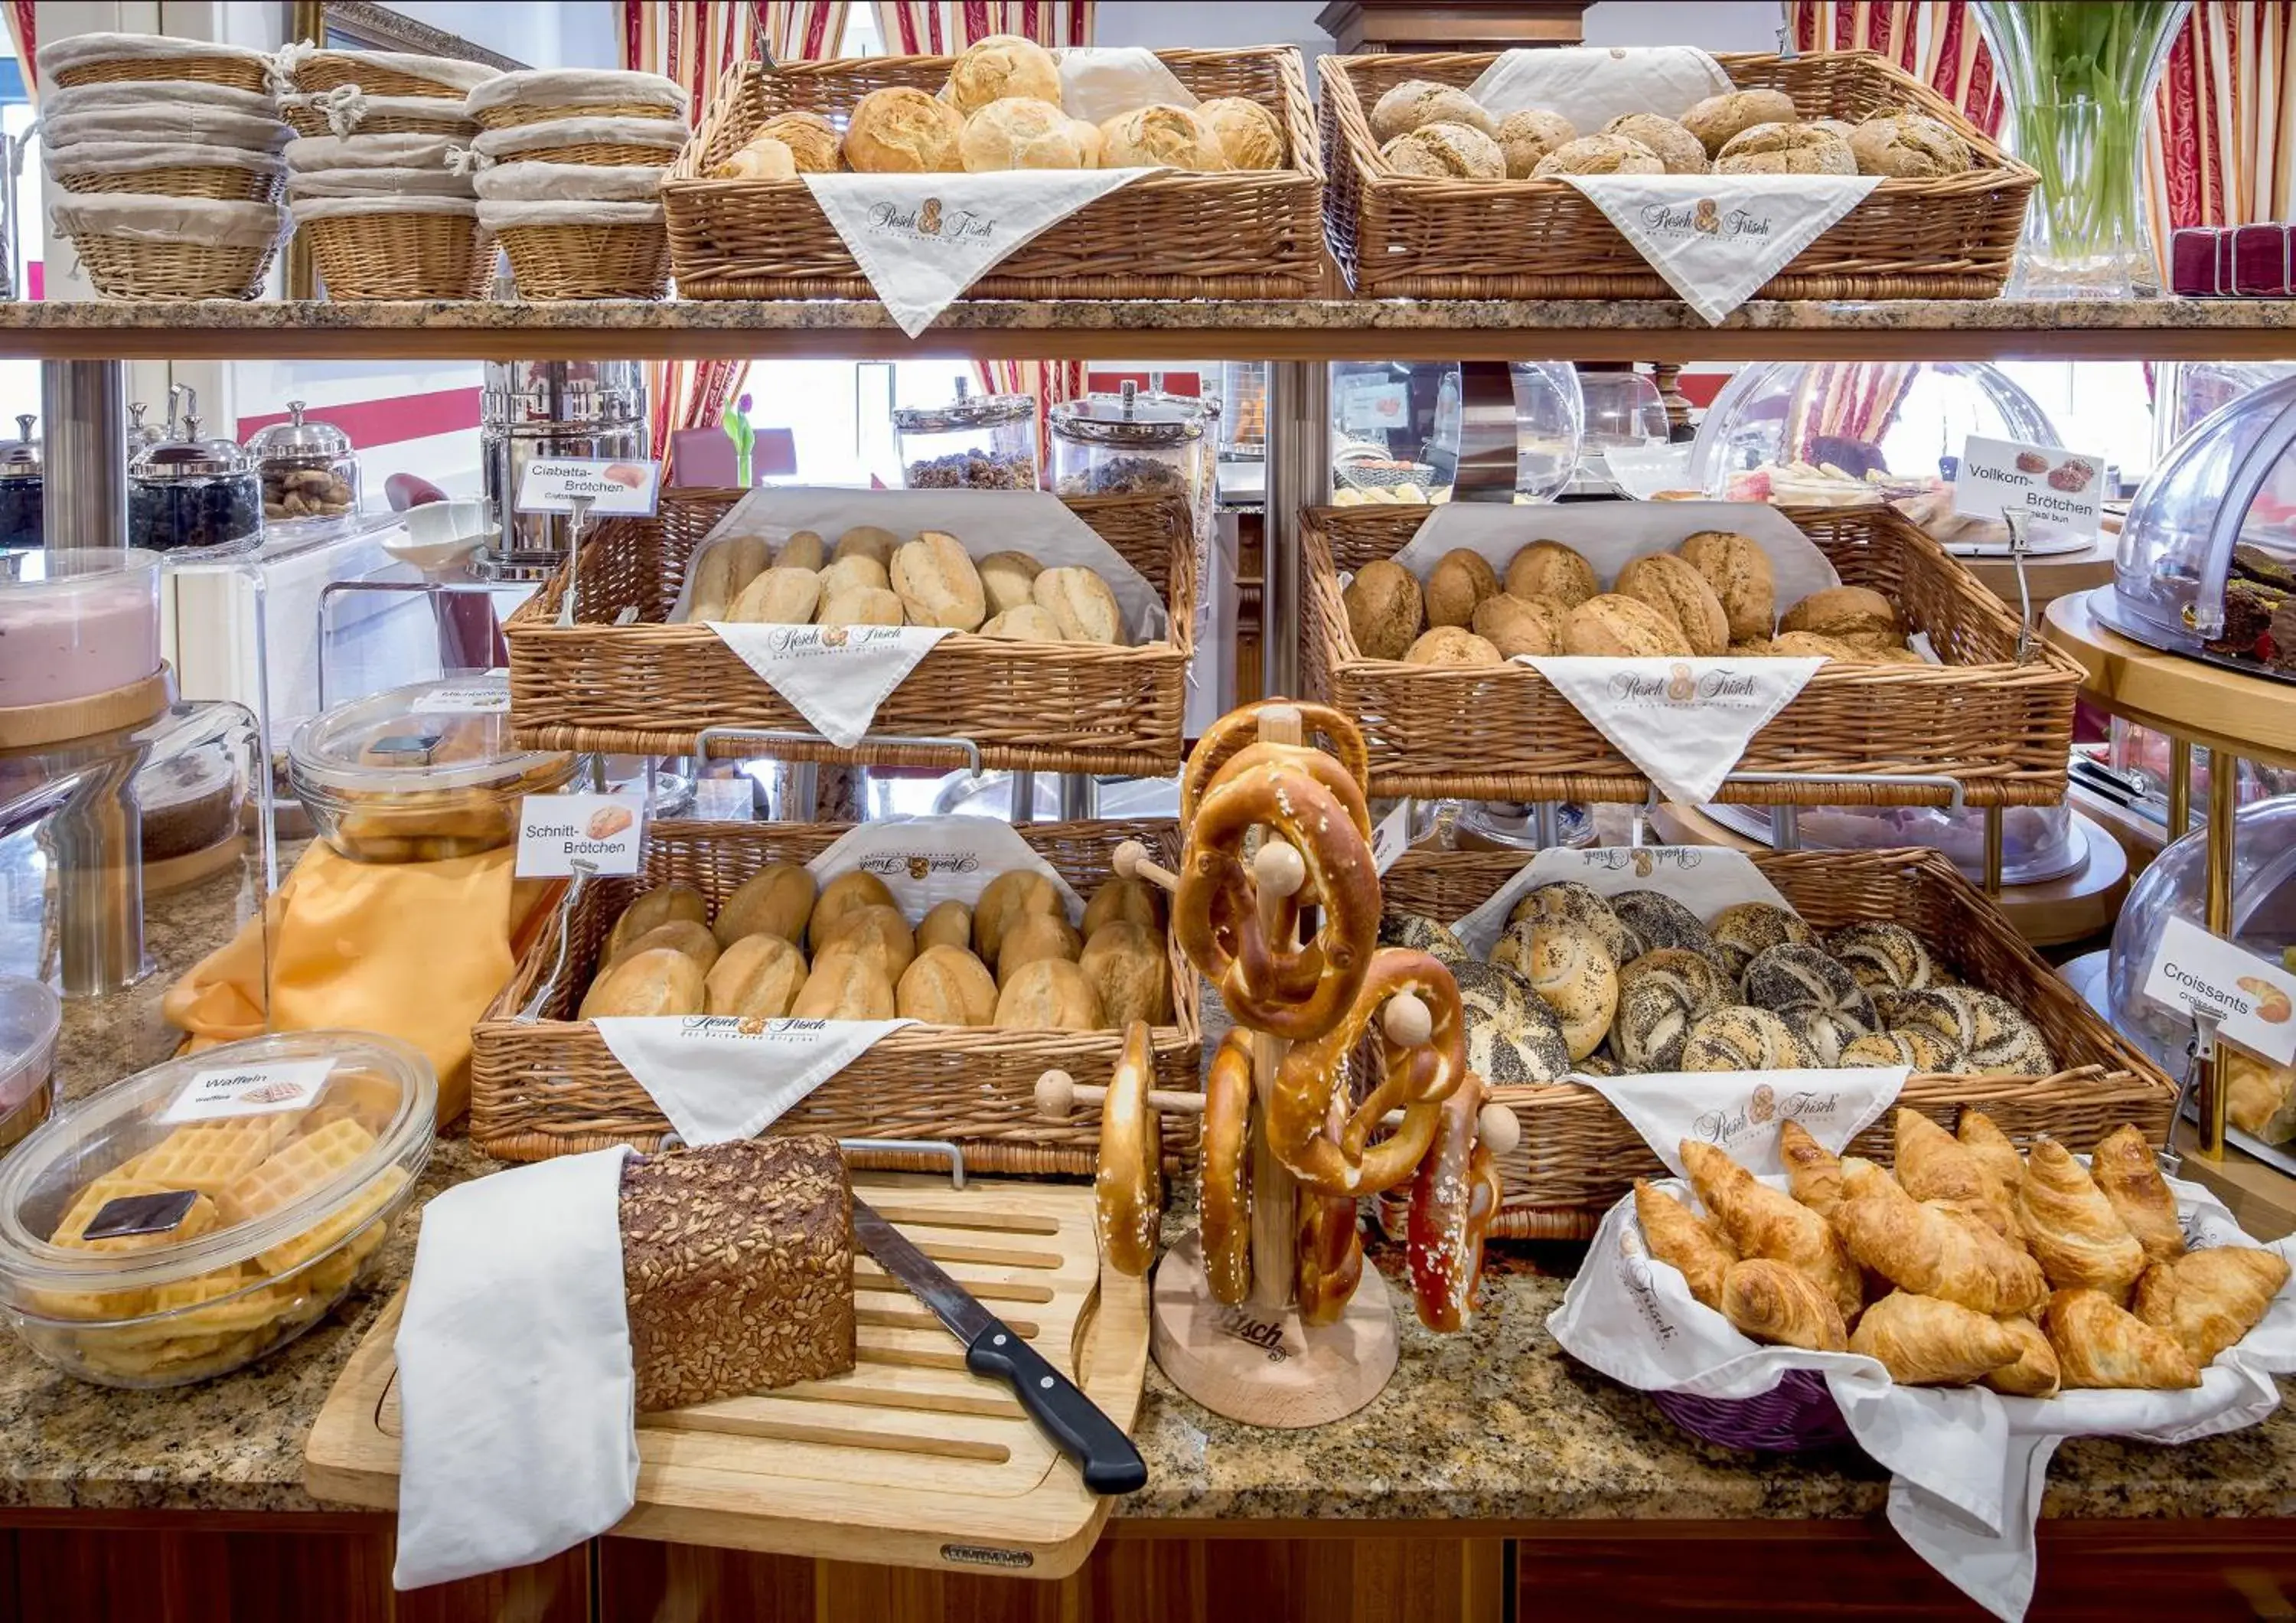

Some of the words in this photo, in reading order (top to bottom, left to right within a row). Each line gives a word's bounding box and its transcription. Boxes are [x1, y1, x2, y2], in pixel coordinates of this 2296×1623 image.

[867, 201, 916, 228] Resch
[944, 211, 994, 237] Frisch
[1640, 203, 1693, 230] Resch
[1722, 209, 1771, 235] Frisch
[532, 465, 593, 478] Ciabatta-
[1969, 463, 2034, 486] Vollkorn-
[564, 480, 625, 492] Brötchen
[2026, 491, 2093, 516] Brötchen
[2052, 513, 2069, 524] bun
[1608, 669, 1664, 702] Resch
[1698, 668, 1757, 699] Frisch
[526, 825, 579, 838] Schnitt-
[563, 841, 625, 854] Brötchen
[2164, 962, 2249, 1014] Croissants
[206, 1073, 268, 1088] Waffeln
[1692, 1105, 1746, 1144] Resch
[1778, 1092, 1838, 1118] Frisch
